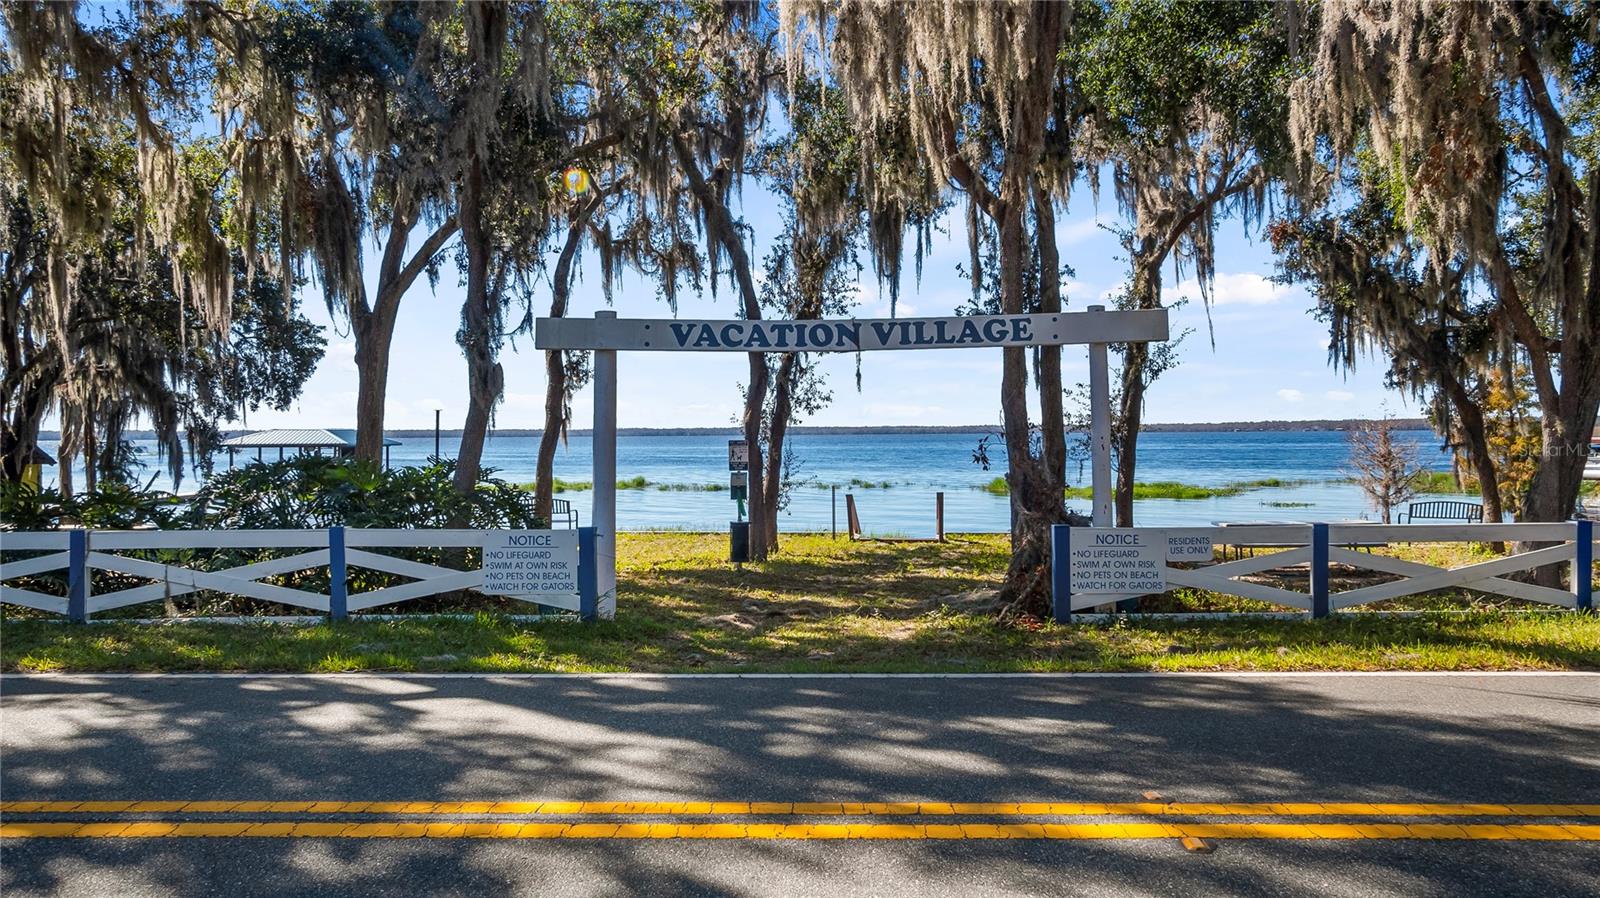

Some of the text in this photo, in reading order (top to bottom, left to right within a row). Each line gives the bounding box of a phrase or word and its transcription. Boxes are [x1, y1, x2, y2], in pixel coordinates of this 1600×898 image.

[669, 317, 1034, 348] VACATION VILLAGE
[508, 535, 552, 546] NOTICE
[1095, 534, 1140, 545] NOTICE
[1168, 537, 1210, 545] RESIDENTS
[1077, 550, 1139, 558] NO LIFEGUARD
[1170, 546, 1209, 555] USE ONLY
[490, 551, 551, 559] NO LIFEGUARD
[1077, 561, 1156, 569] SWIM AT OWN RISK
[490, 572, 571, 580] NO PETS ON BEACH
[1077, 571, 1159, 579] NO PETS ON BEACH
[489, 583, 575, 591] WATCH FOR GATORS
